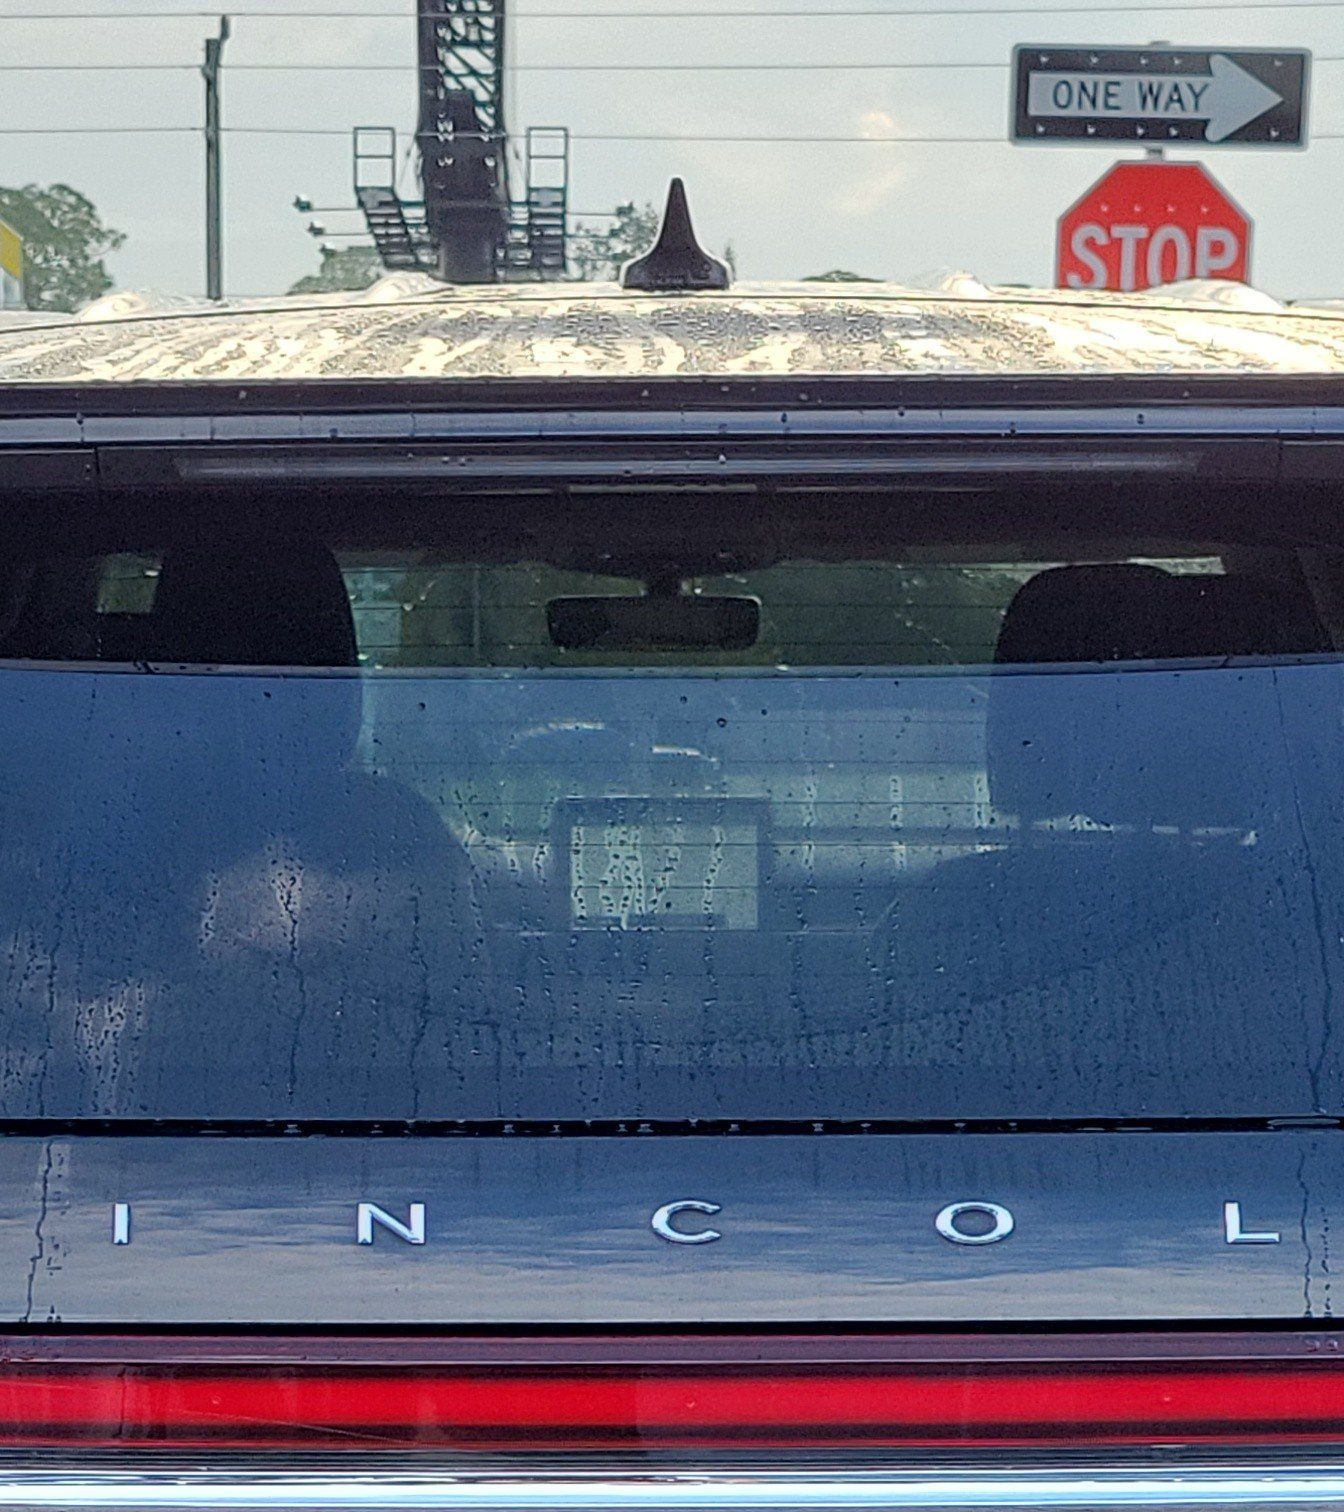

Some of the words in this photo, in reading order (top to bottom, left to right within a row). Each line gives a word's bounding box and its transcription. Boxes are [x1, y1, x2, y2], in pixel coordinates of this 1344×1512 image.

[1052, 79, 1122, 111] ONE
[1137, 80, 1210, 113] WAY
[1067, 225, 1239, 291] STOP
